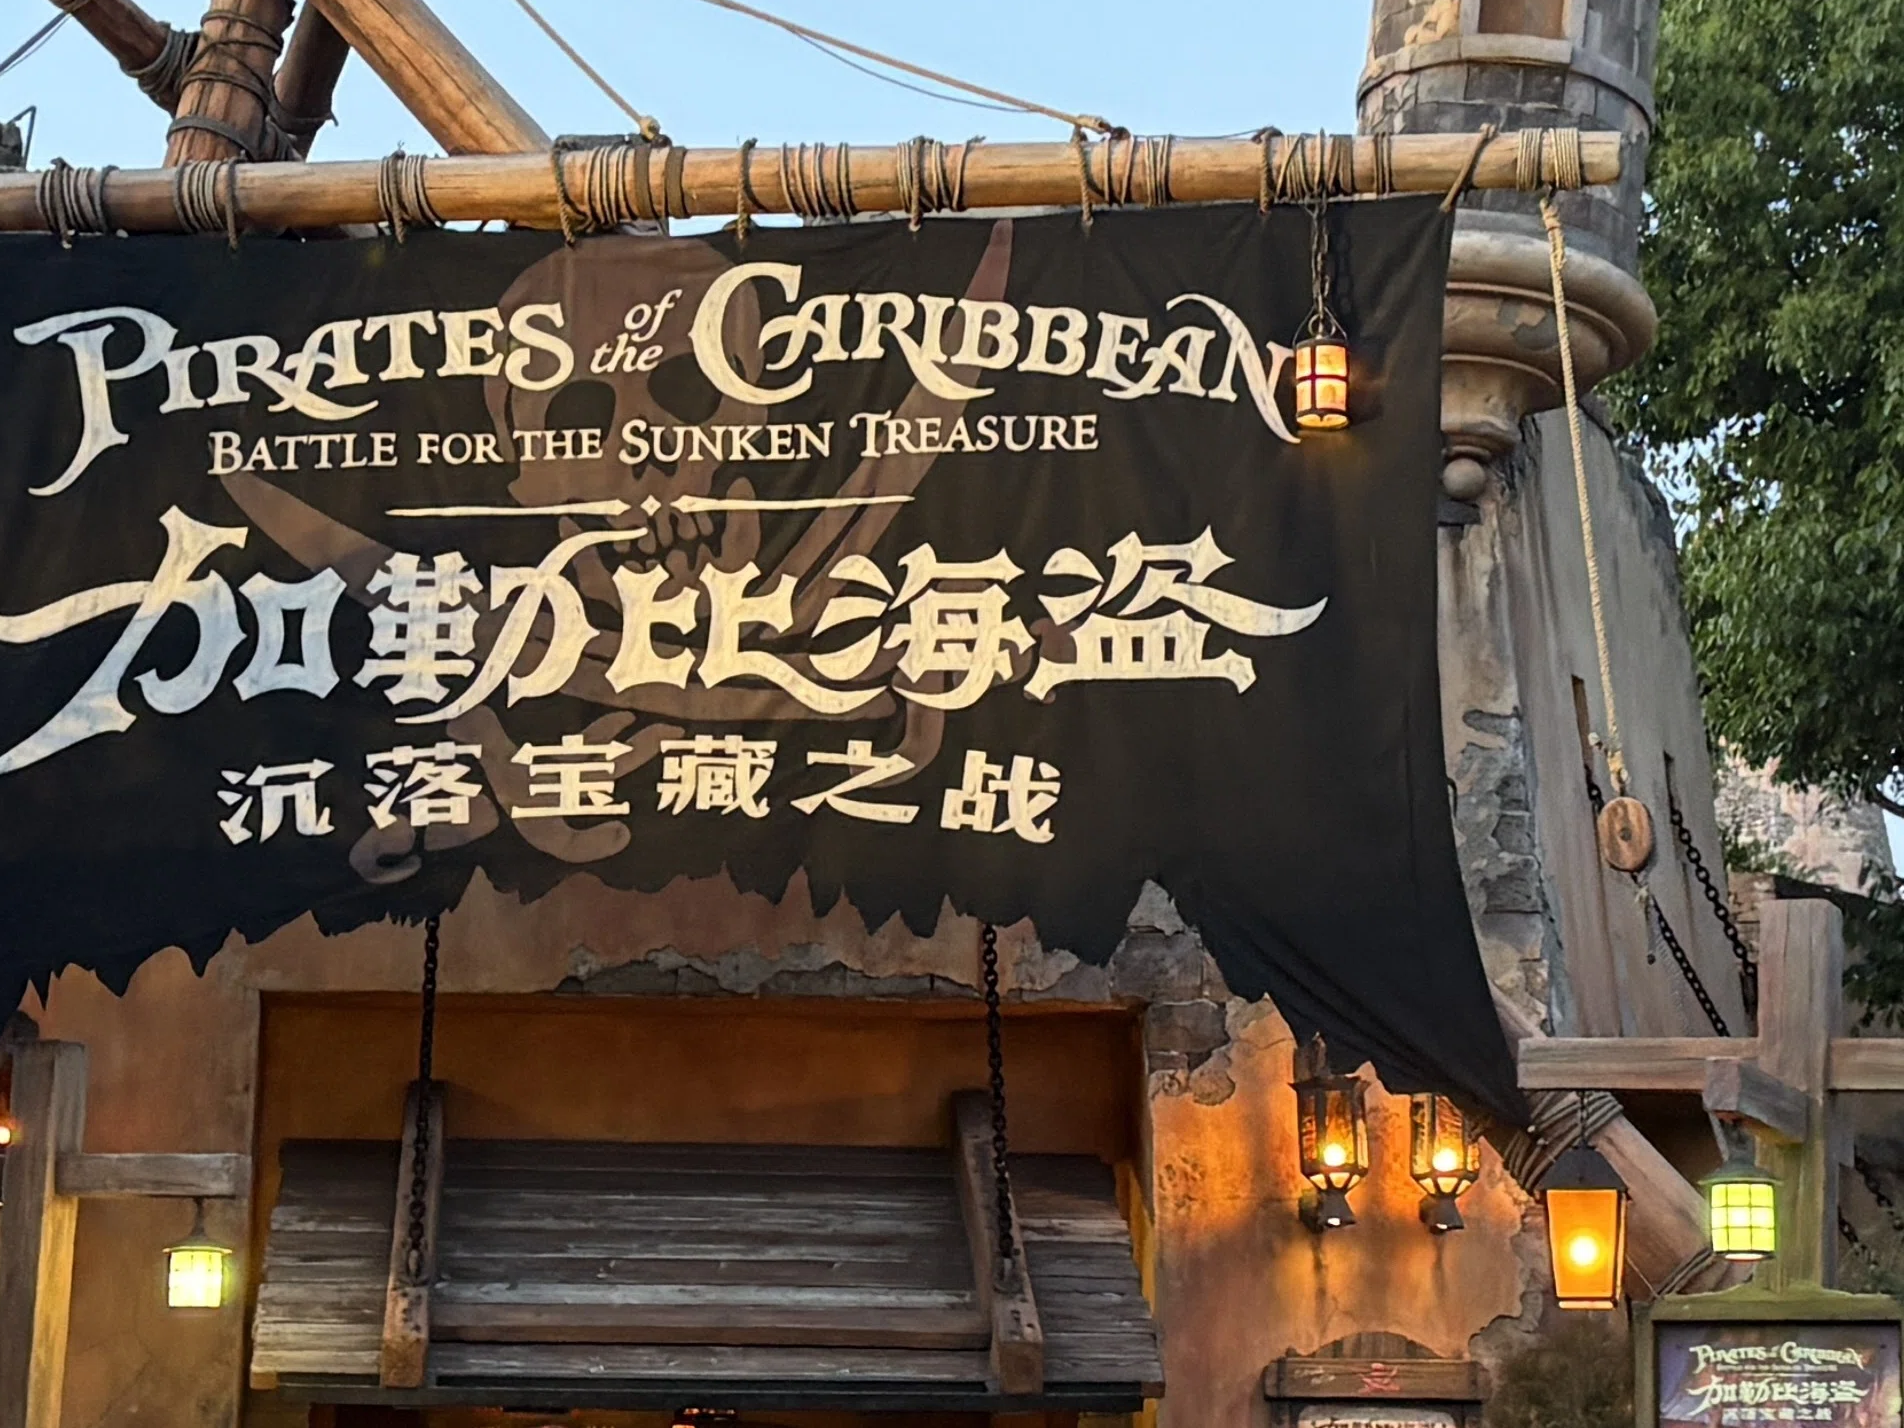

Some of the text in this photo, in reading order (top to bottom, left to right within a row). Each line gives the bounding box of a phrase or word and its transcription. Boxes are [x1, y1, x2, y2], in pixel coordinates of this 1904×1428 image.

[13, 262, 1302, 497] PIRATES of the CARIBBEAN
[207, 409, 1100, 475] BATTLE FOR THE SUNKEN TREASURE
[217, 734, 1063, 845] 沉落宝藏之战
